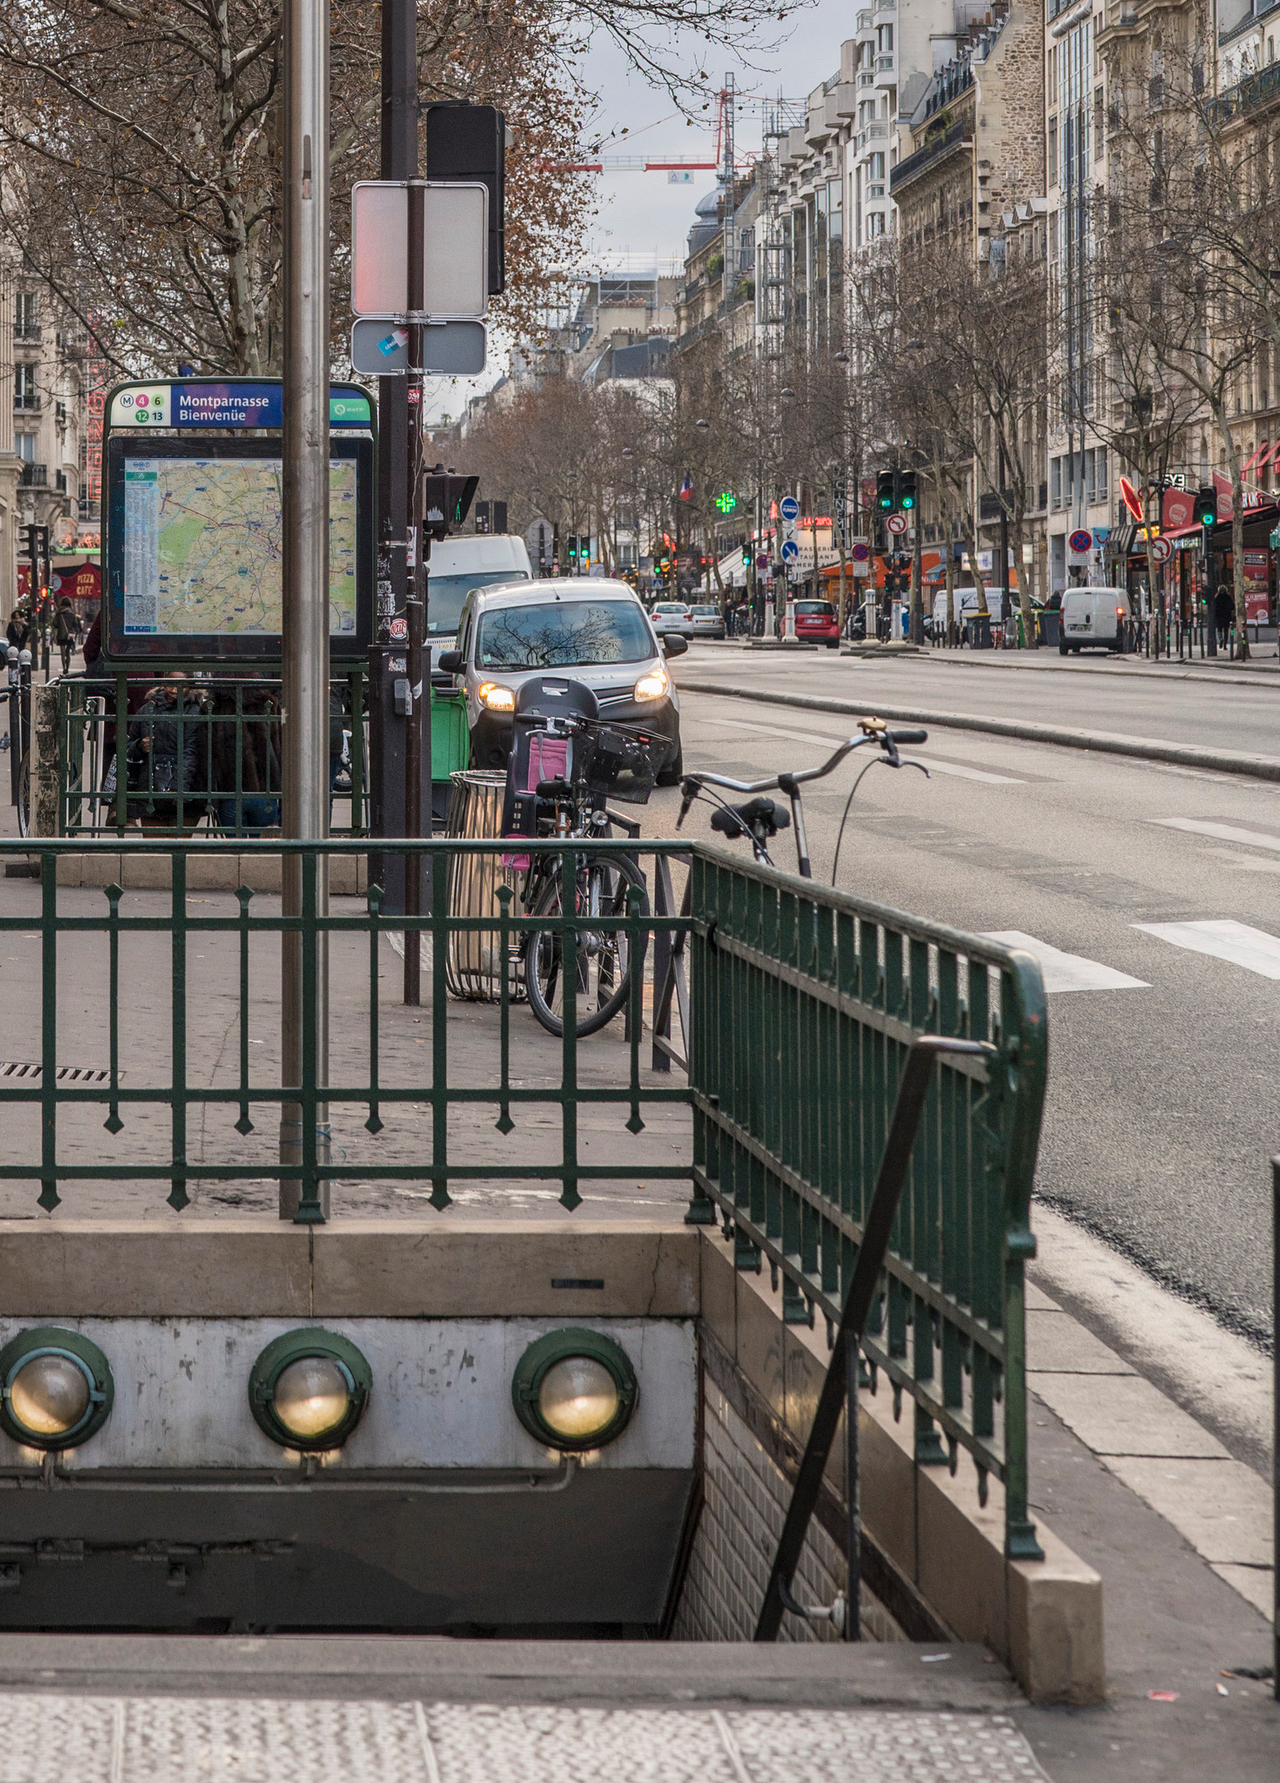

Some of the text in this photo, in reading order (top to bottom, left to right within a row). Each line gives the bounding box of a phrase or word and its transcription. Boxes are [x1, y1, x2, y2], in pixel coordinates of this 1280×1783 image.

[138, 396, 146, 406] 4
[154, 396, 161, 406] 6
[179, 395, 270, 410] Montparnasse
[136, 412, 163, 421] 12 13
[179, 409, 246, 421] Bienvenüe
[77, 574, 95, 584] PIZZA
